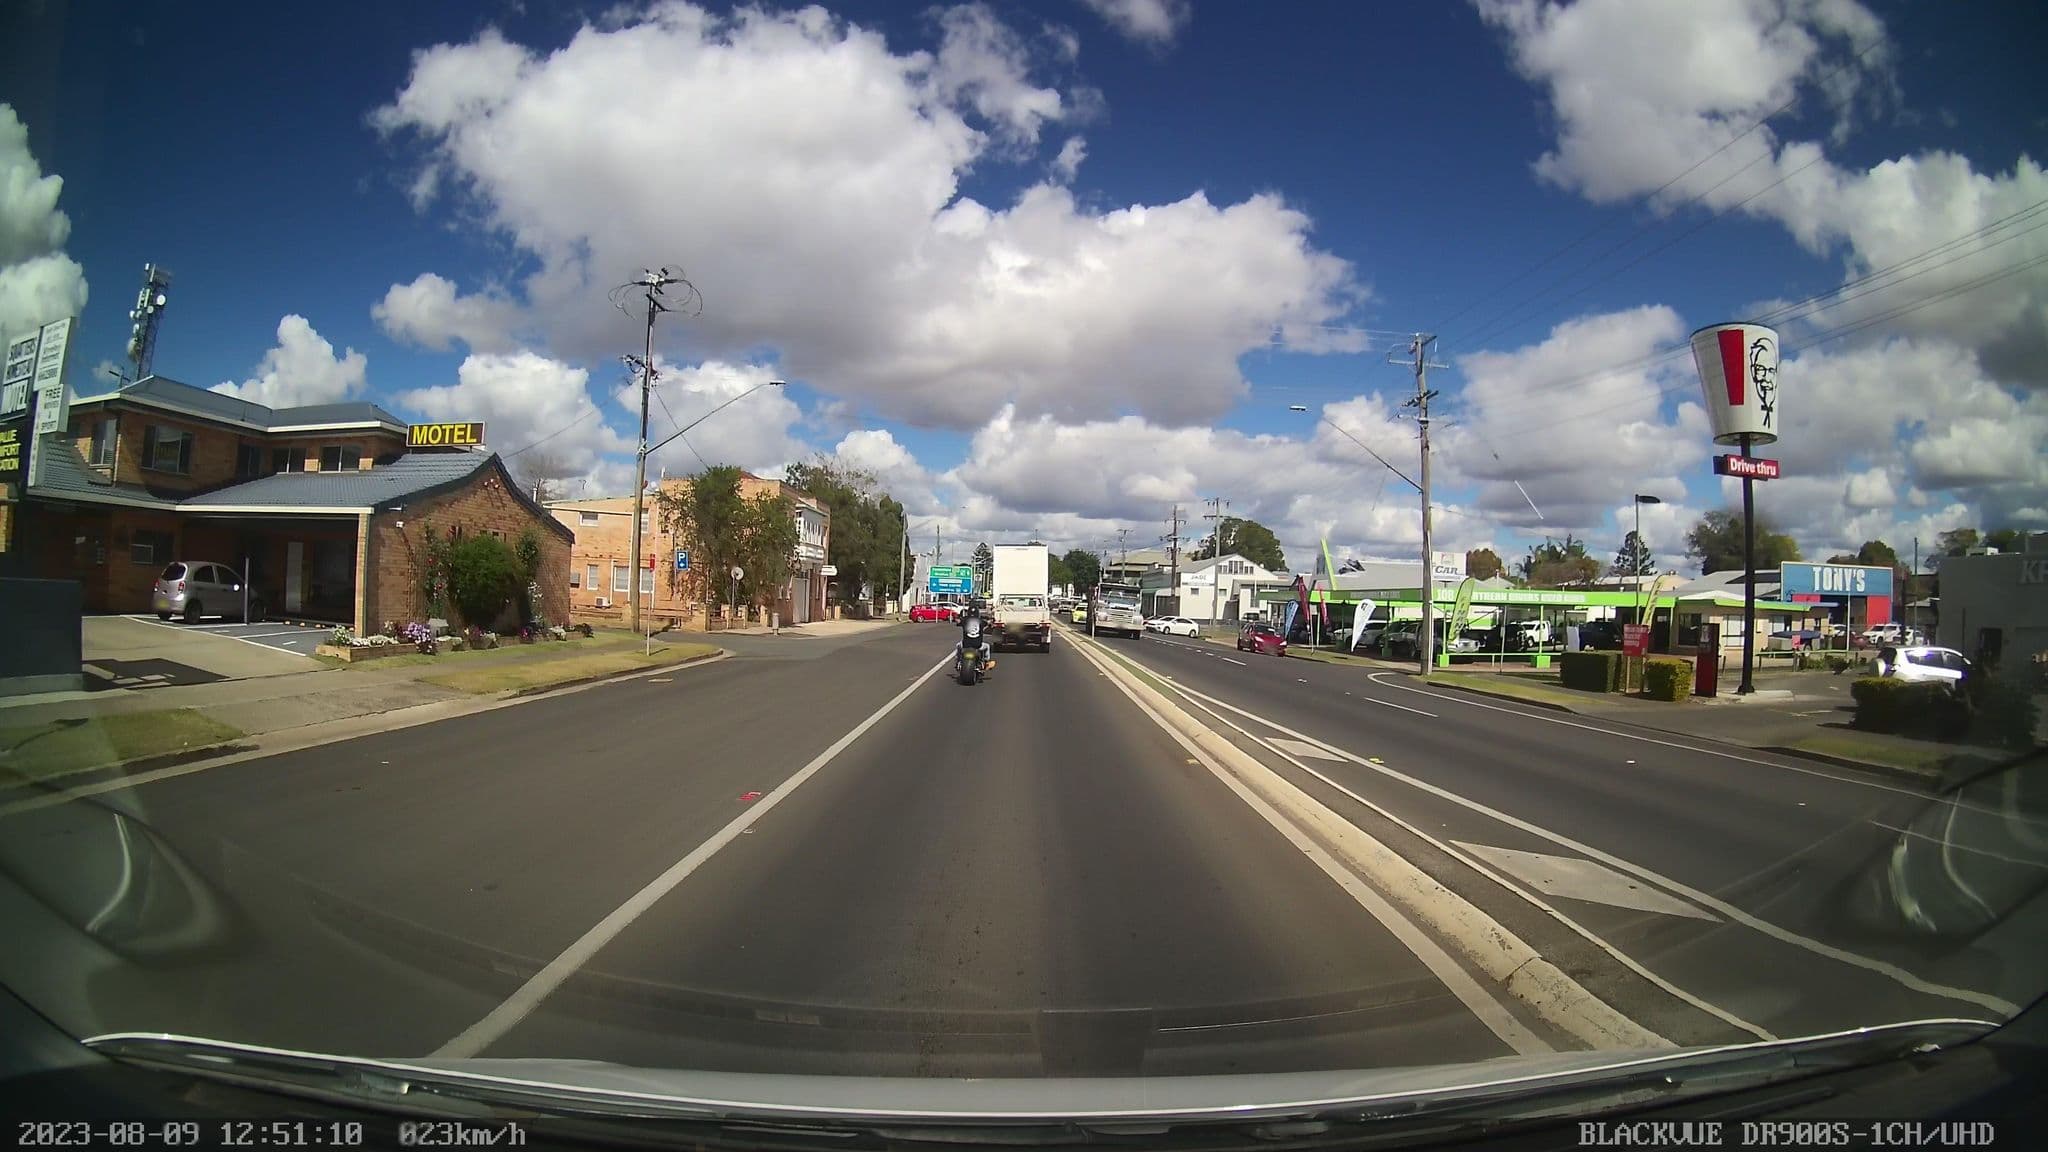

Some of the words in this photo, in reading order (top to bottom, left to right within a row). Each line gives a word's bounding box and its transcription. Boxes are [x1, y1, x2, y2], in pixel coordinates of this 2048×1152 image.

[412, 424, 477, 444] MOTEL
[1730, 458, 1756, 474] Drive
[1757, 462, 1776, 476] thru
[678, 552, 686, 562] P
[1813, 566, 1866, 592] TONY'S
